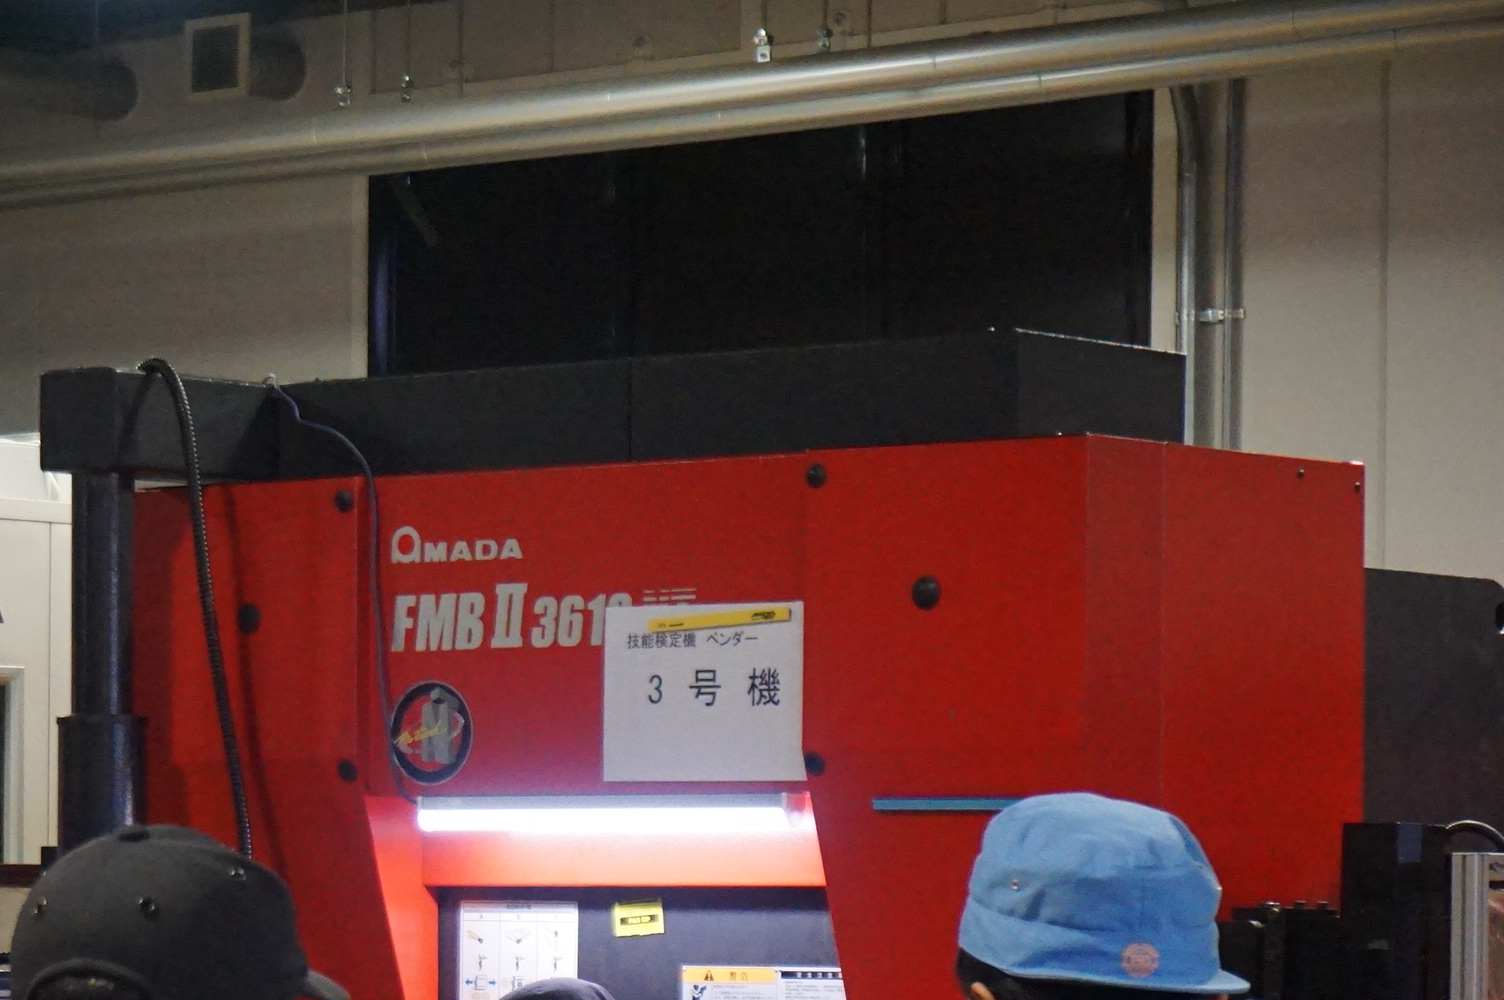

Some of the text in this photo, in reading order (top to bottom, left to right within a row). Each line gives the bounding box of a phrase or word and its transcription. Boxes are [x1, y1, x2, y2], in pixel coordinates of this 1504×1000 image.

[391, 526, 523, 564] AMADA
[391, 592, 486, 652] FMB
[627, 631, 759, 650] 技能検定機 ベンダー
